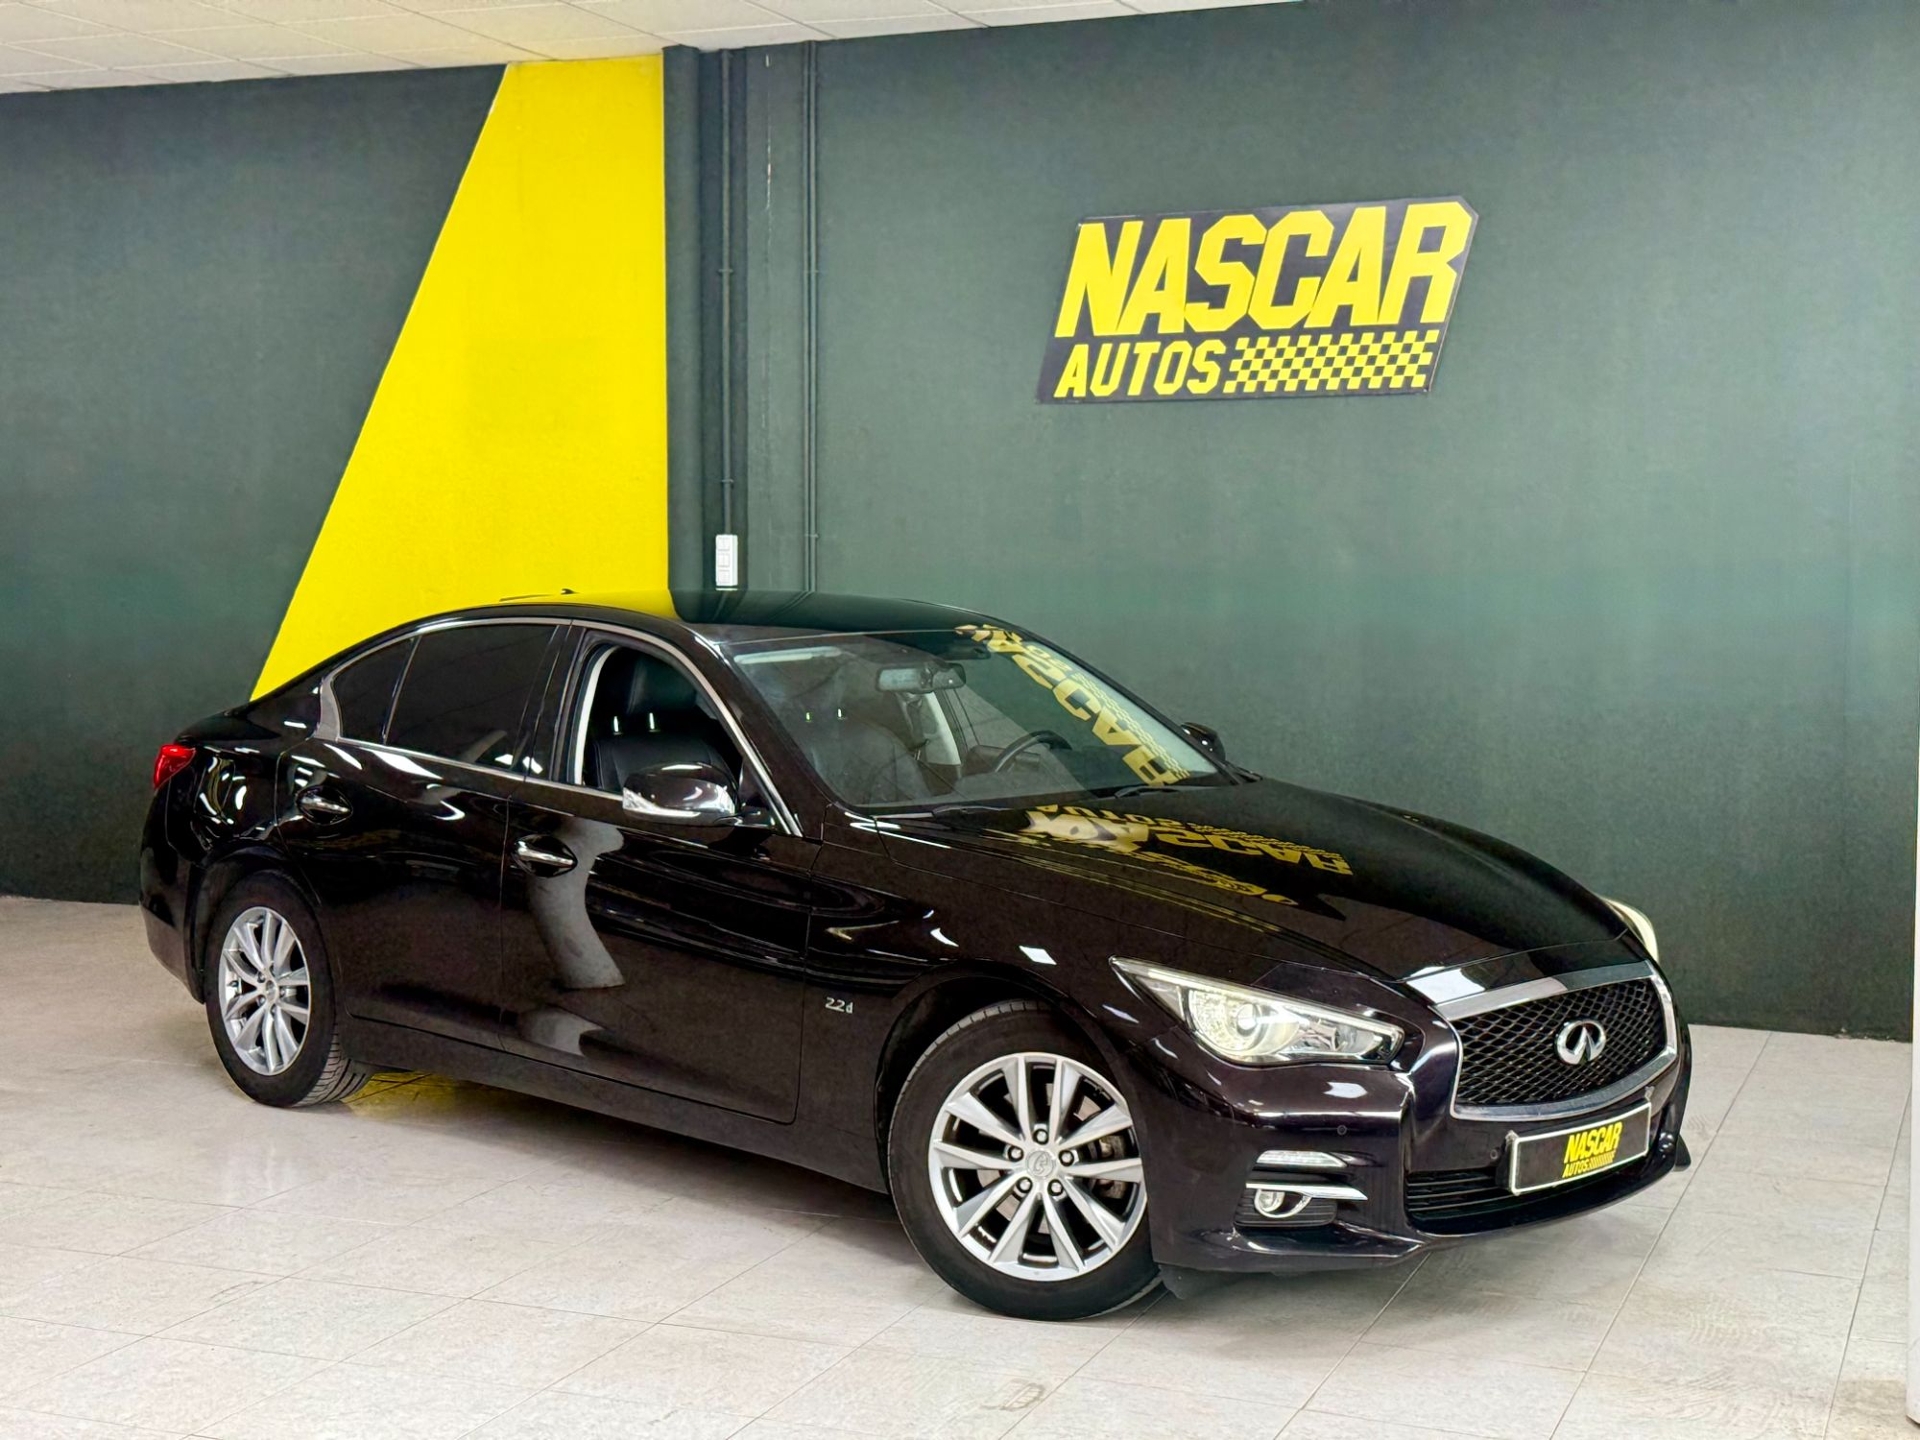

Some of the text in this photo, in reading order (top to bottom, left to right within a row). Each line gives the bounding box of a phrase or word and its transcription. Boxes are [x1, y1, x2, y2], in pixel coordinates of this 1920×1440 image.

[1055, 201, 1473, 337] NASCAR
[1054, 339, 1226, 397] AUTOS
[1564, 1121, 1622, 1164] NASCAR
[1562, 1158, 1590, 1178] AUTOS
